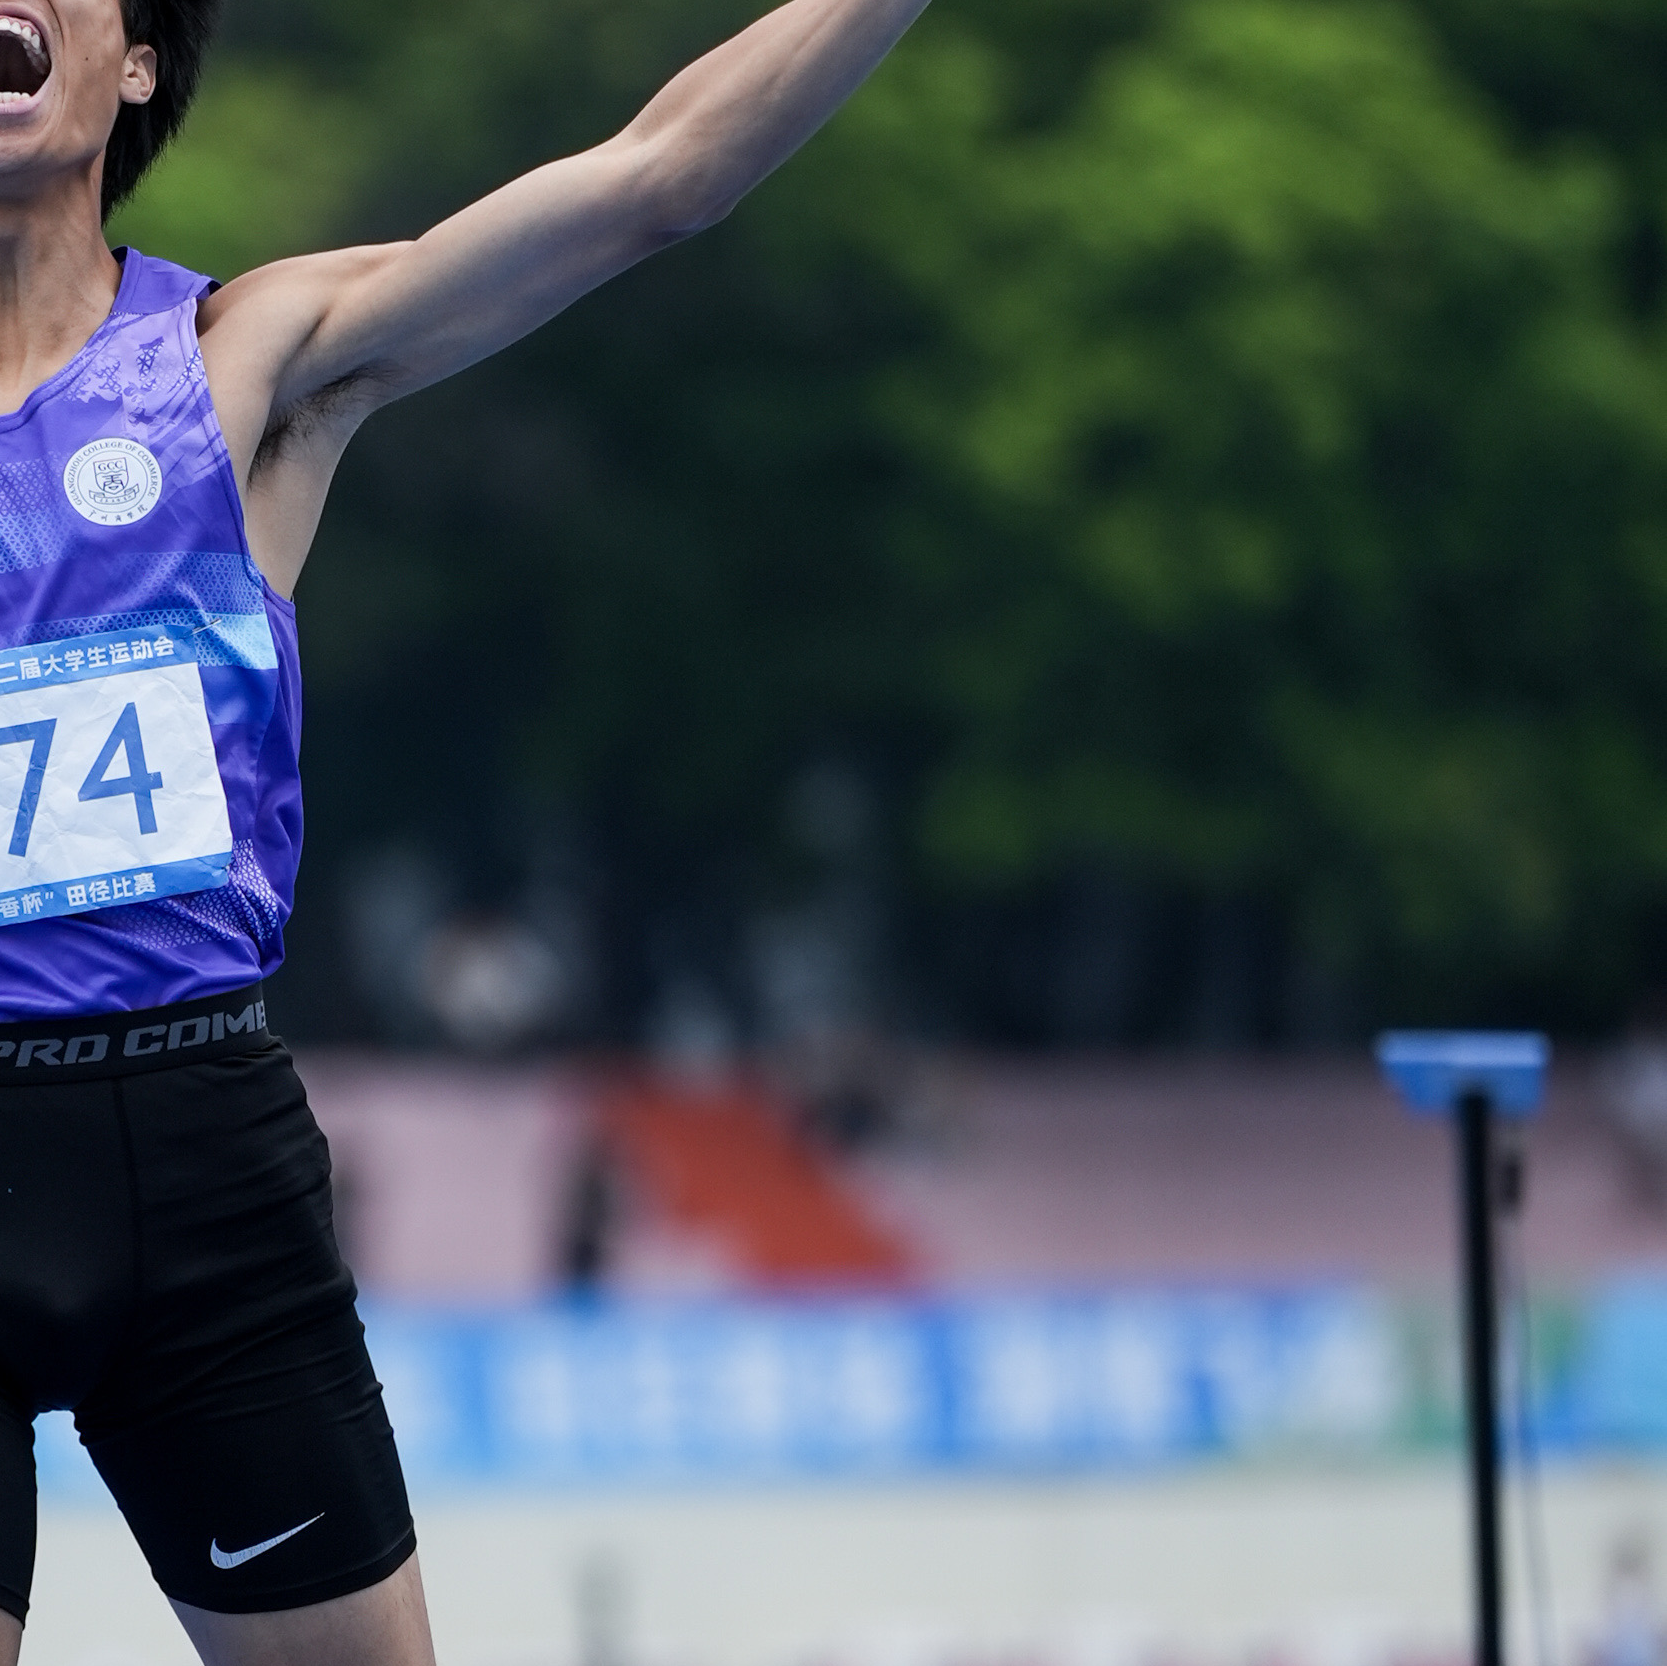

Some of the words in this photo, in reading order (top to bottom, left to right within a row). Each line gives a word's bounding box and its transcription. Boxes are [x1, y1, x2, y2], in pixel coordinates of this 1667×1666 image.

[67, 455, 84, 506] GUANGZHOU
[83, 441, 123, 456] COLLEGE
[125, 443, 138, 452] OF
[137, 450, 158, 498] COMMERCE
[98, 460, 123, 472] GCC
[66, 872, 157, 907] 田径比赛
